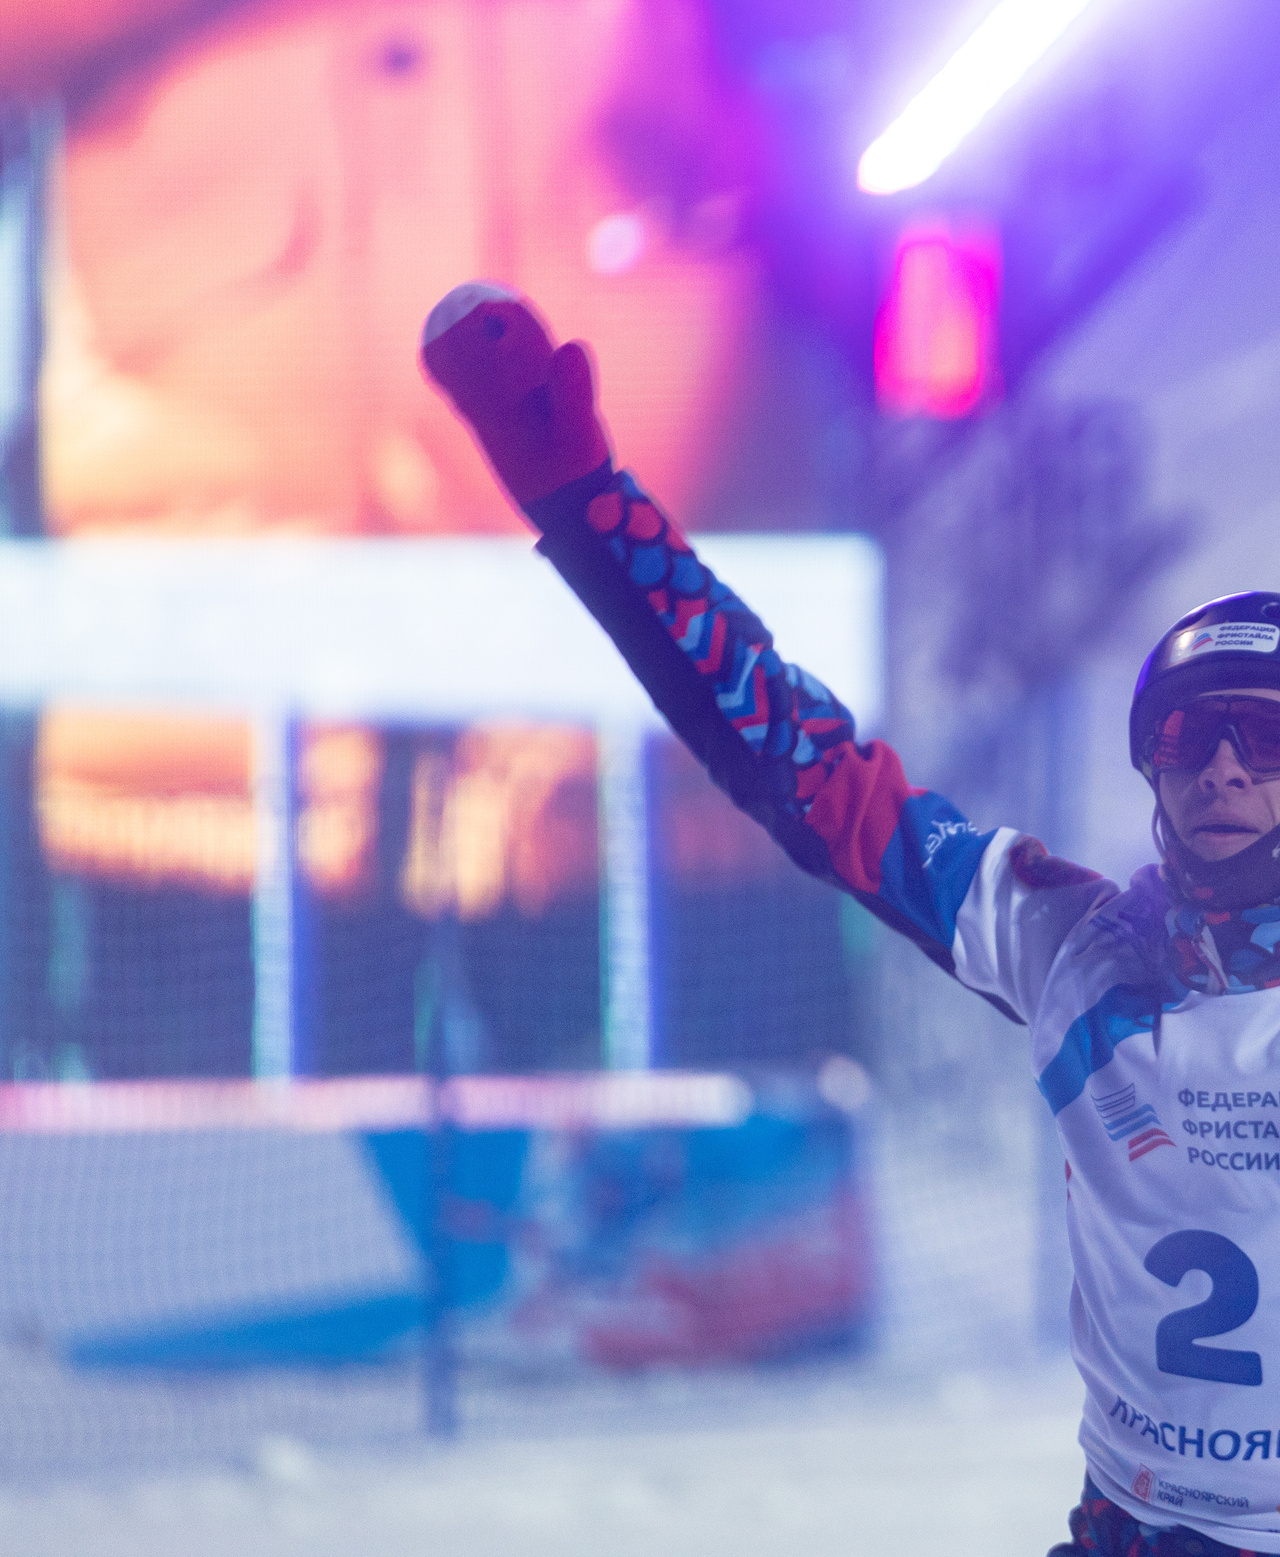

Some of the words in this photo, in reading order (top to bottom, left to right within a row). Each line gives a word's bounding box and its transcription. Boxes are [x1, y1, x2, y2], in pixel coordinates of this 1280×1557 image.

[1219, 625, 1276, 633] ФЕДЕРАЦИЯ
[1187, 1147, 1280, 1171] РОССИИ
[1143, 1229, 1263, 1387] 2
[1157, 1490, 1184, 1506] КРАЙ
[1158, 1480, 1249, 1508] КРАСНОЯРСКИЙ
